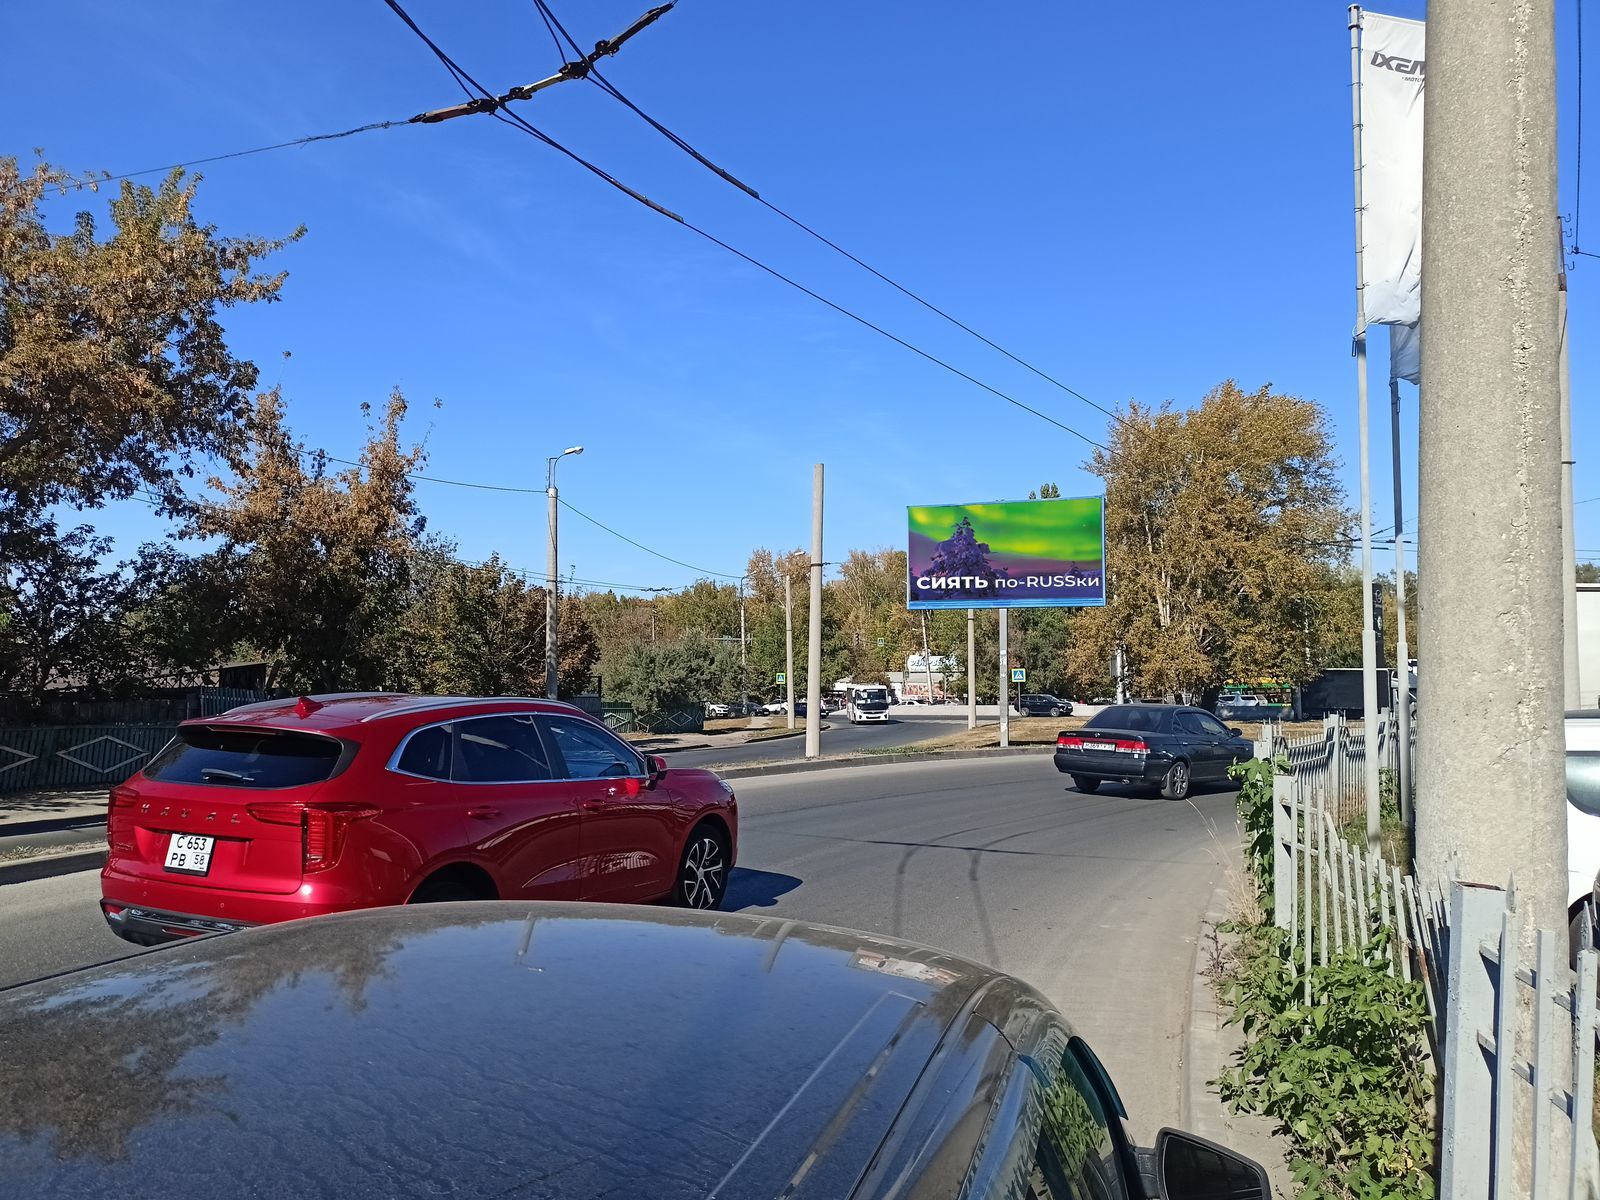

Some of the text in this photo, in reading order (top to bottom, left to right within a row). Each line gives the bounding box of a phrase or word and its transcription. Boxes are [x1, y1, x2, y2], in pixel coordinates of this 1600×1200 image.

[916, 575, 1100, 590] СИЯТЬ по-RUSSки
[193, 854, 205, 865] 58
